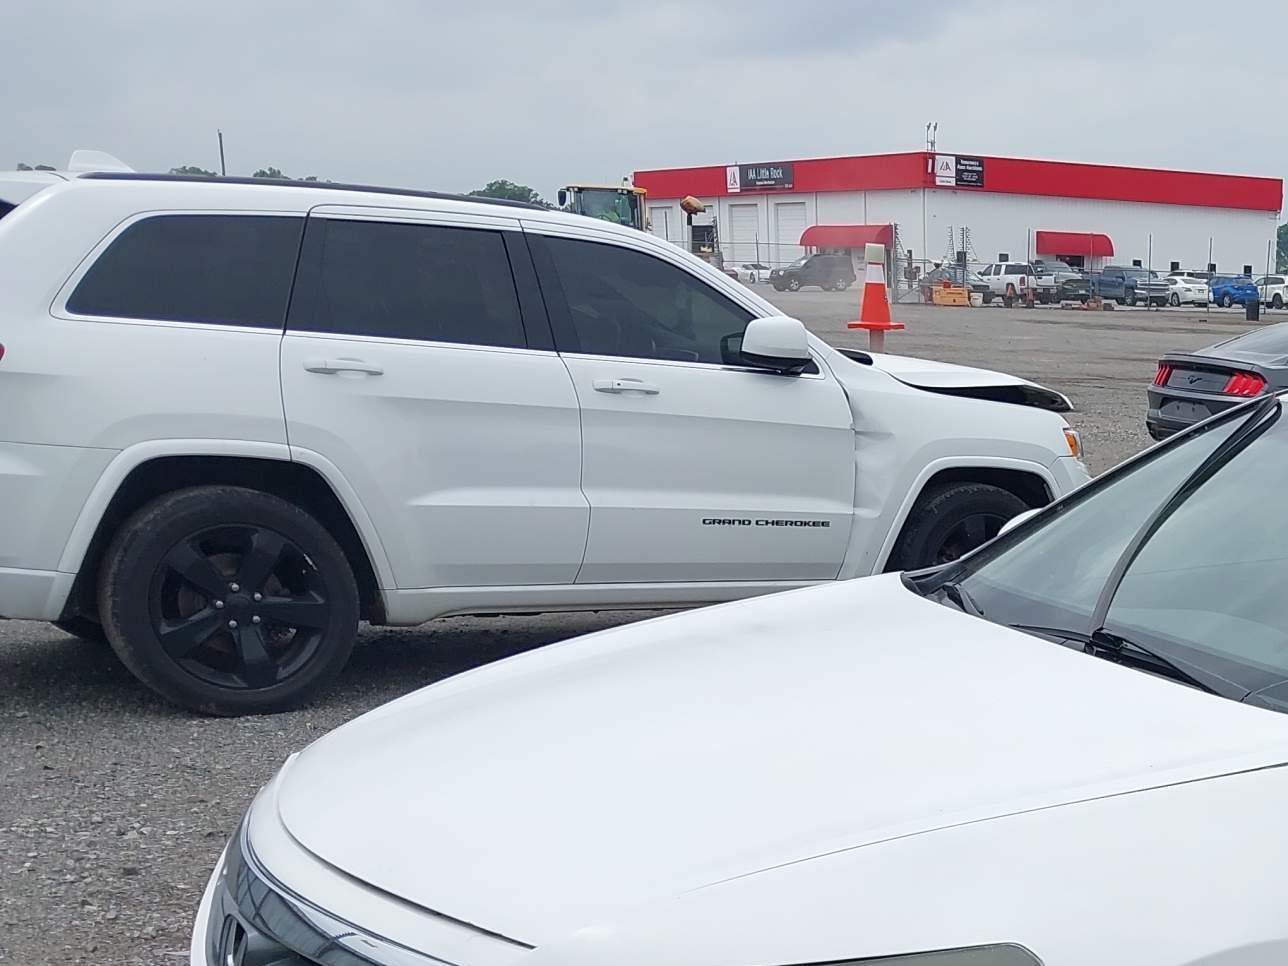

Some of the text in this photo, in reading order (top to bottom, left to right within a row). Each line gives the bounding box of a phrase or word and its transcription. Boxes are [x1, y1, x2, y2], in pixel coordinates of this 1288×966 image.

[757, 167, 770, 180] Little
[771, 166, 784, 179] Rock
[701, 518, 831, 528] GRAND CHEROKEE
